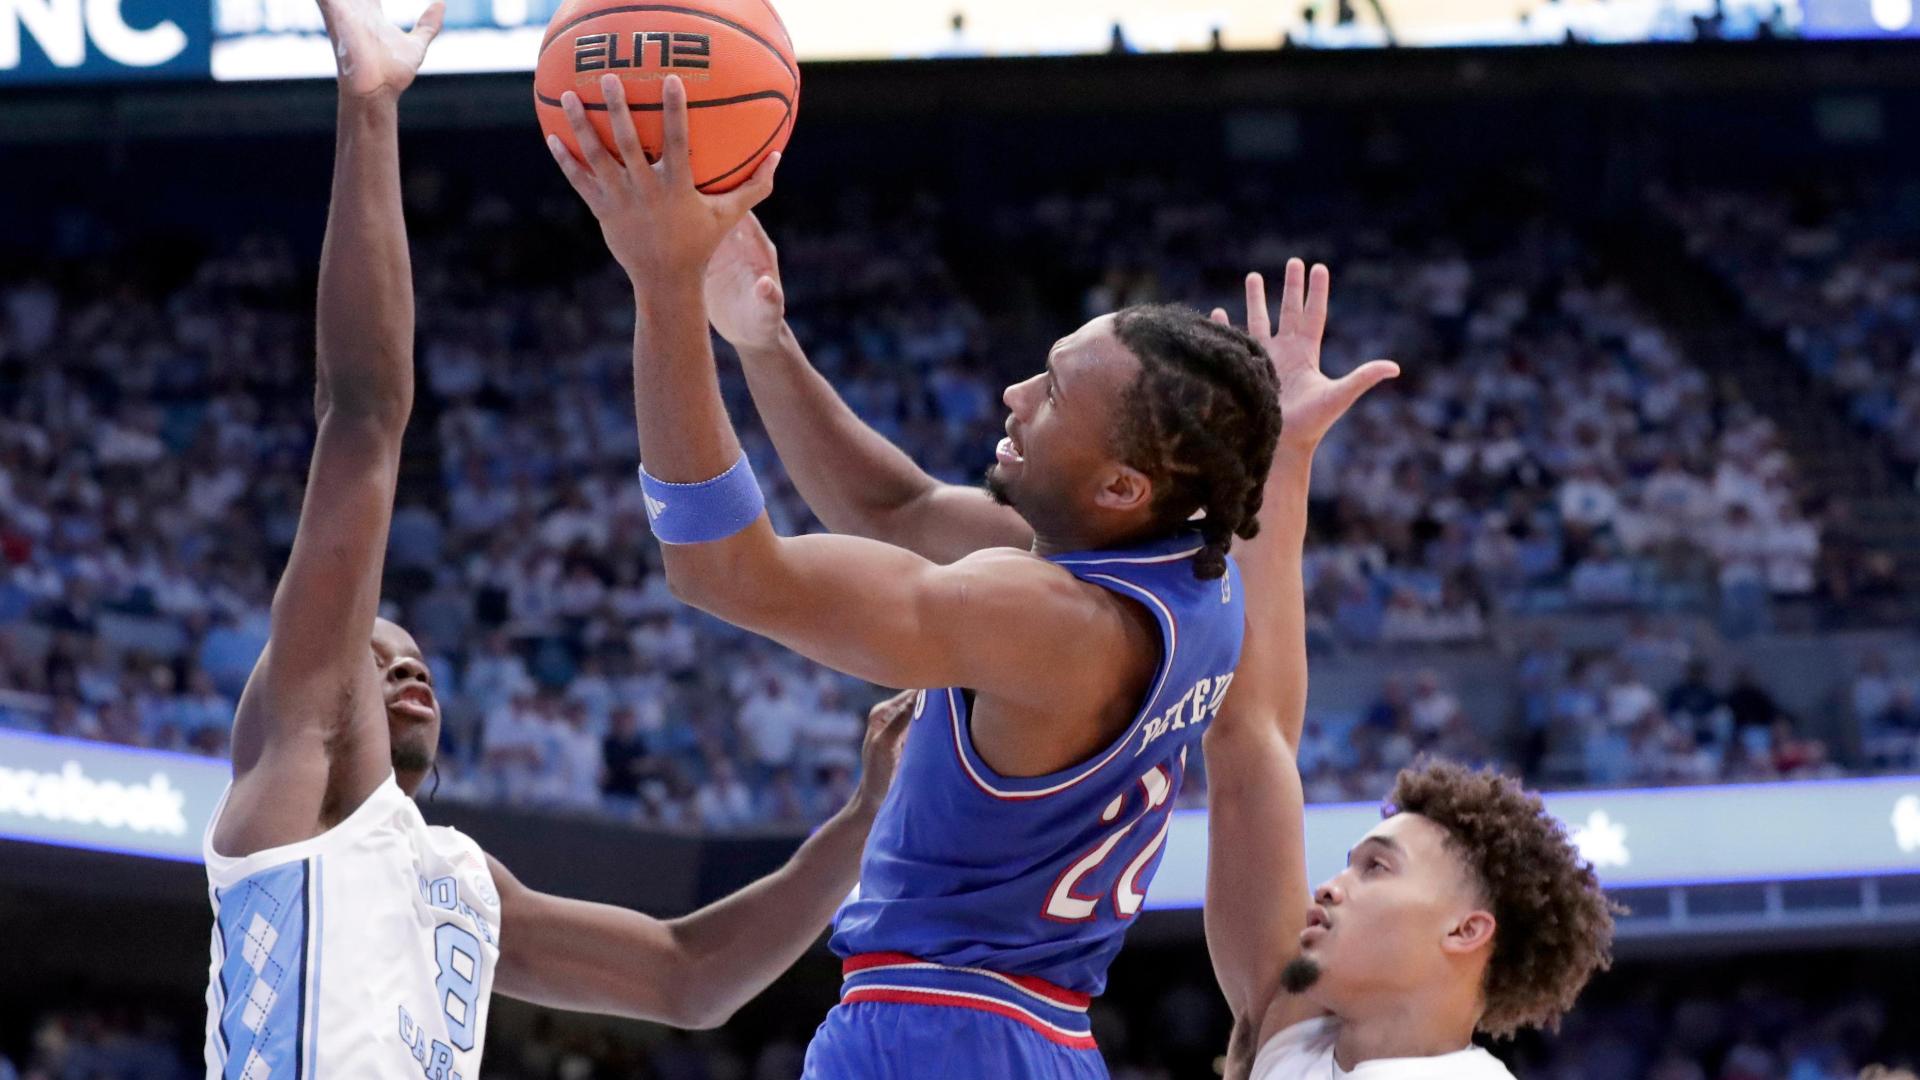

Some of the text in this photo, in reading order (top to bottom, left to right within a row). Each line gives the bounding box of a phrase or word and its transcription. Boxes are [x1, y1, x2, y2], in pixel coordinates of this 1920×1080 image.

[574, 31, 711, 73] ELITE
[435, 922, 482, 1052] 8
[398, 1004, 459, 1080] CAR
